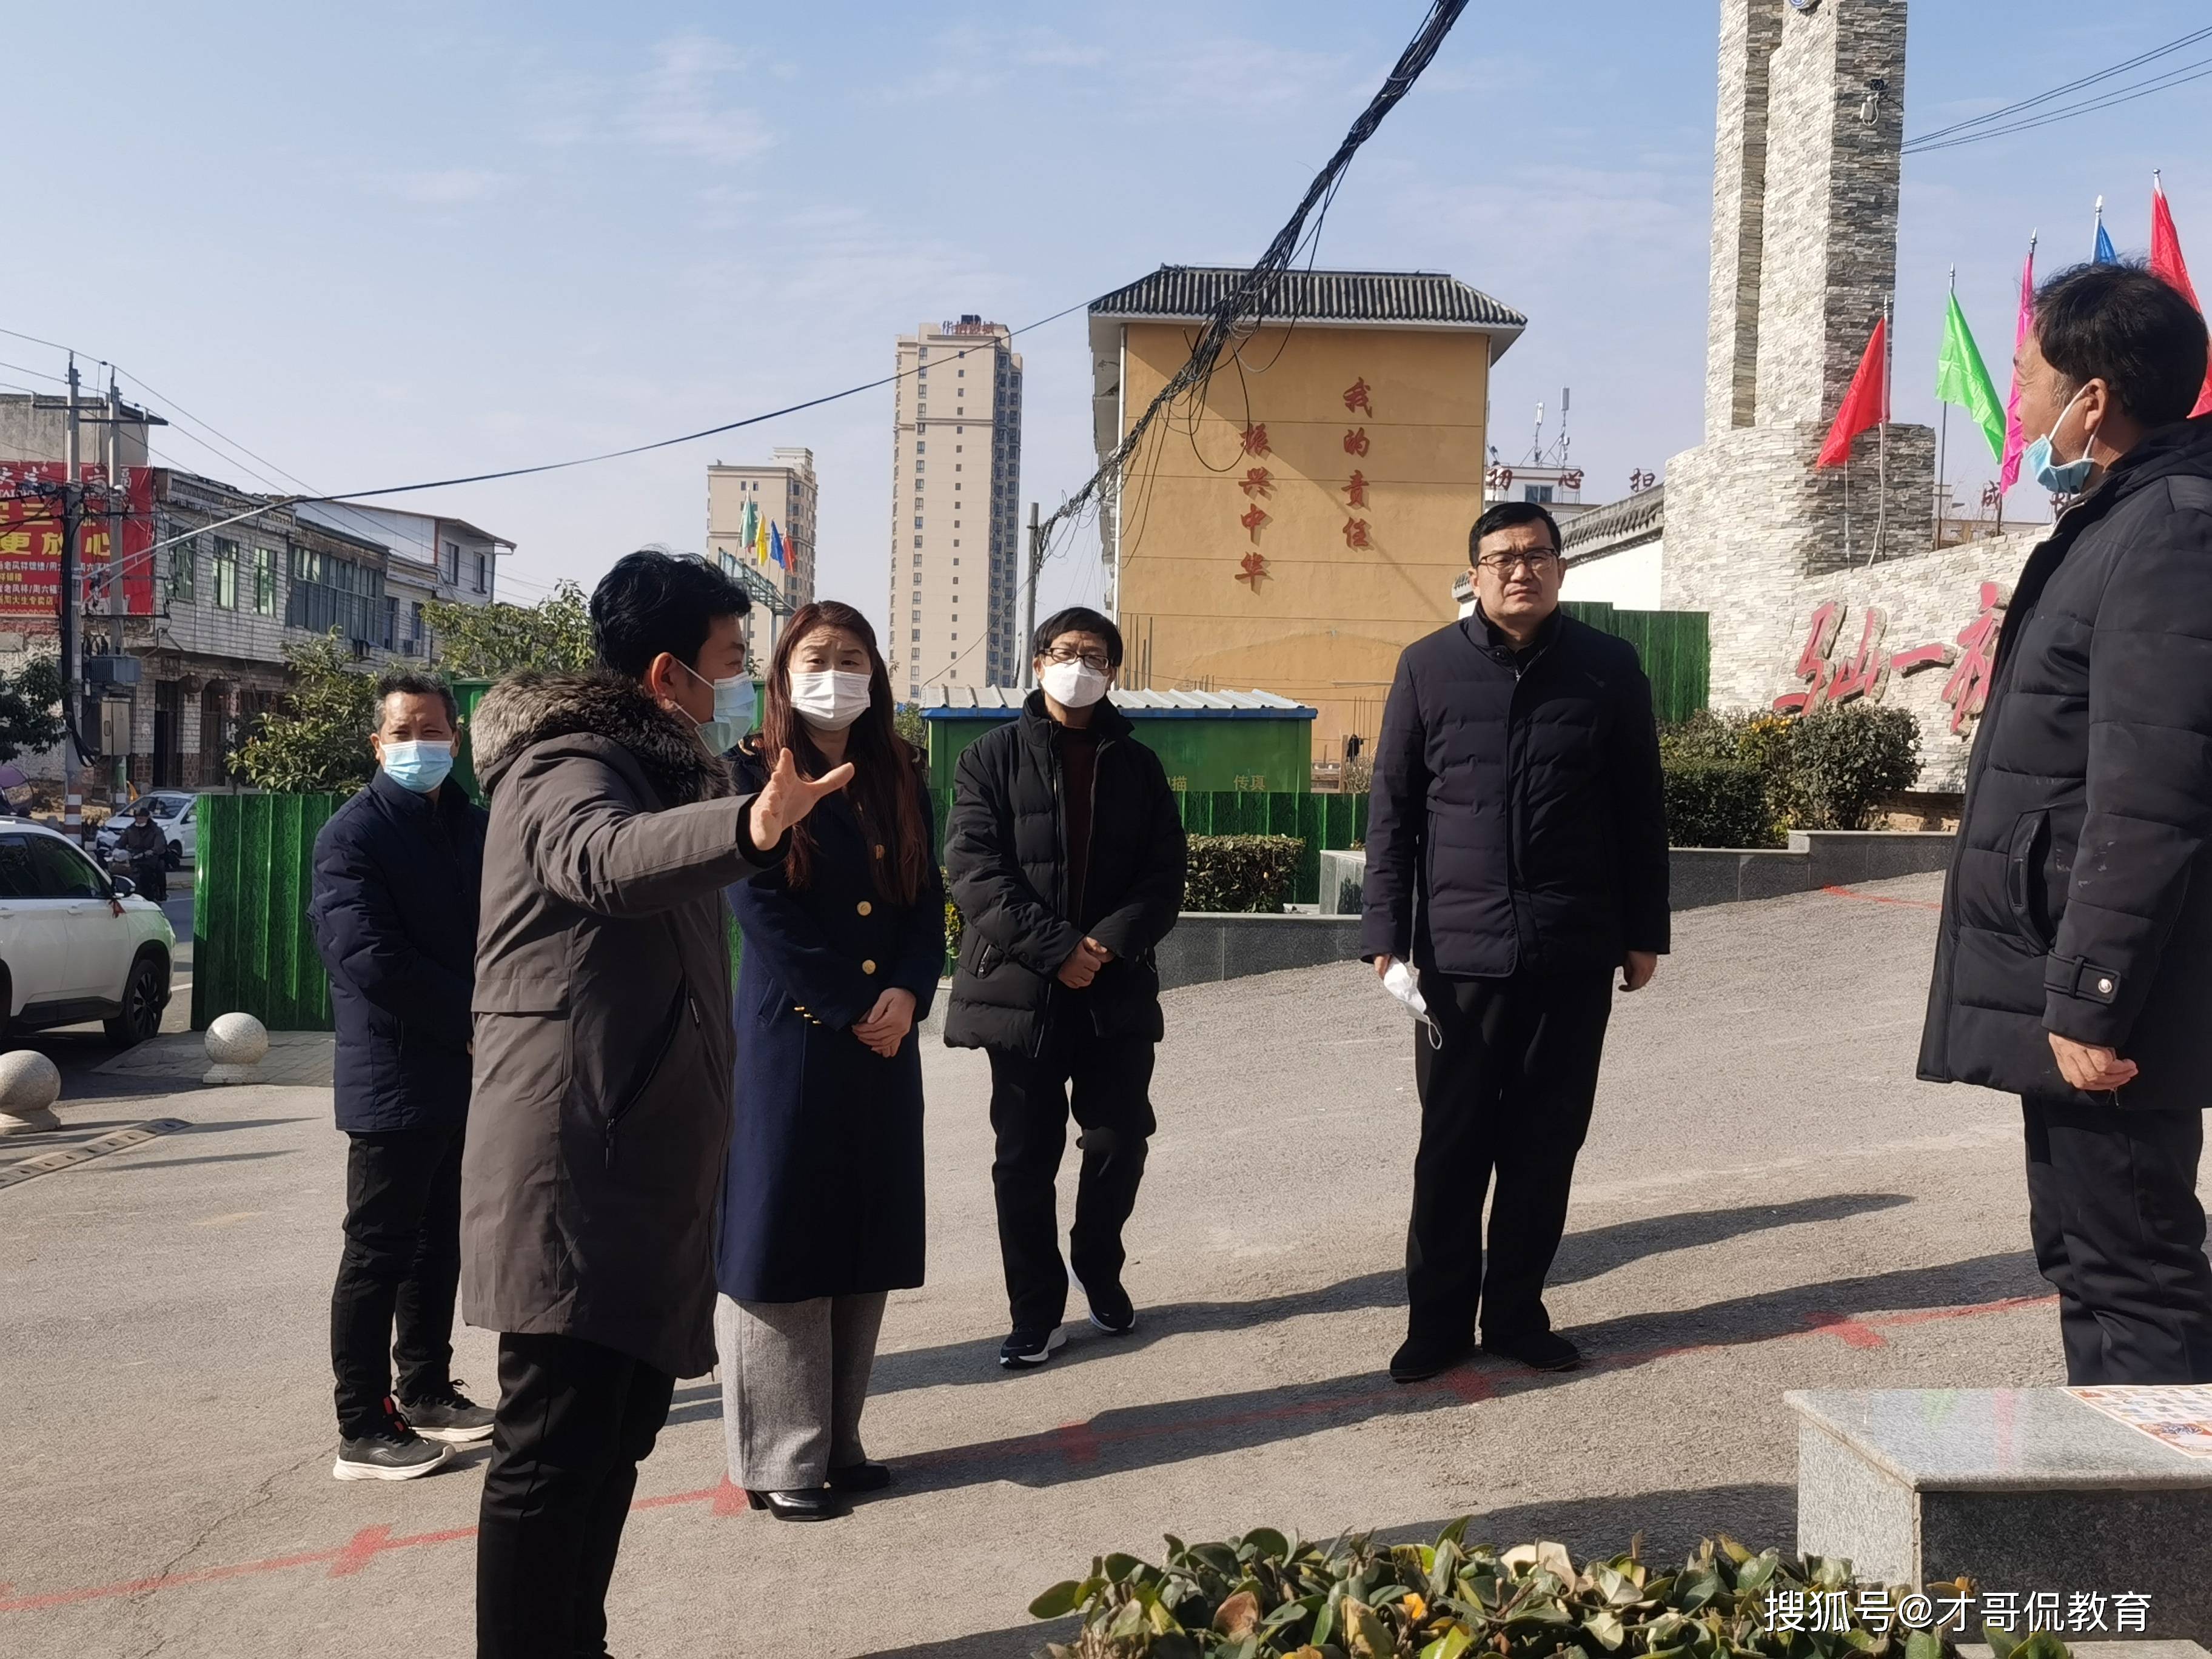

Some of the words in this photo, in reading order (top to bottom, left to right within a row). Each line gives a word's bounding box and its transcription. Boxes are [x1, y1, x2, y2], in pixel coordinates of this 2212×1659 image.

[1235, 423, 1273, 594] 振兴中华
[1341, 377, 1373, 551] 我的责任
[1233, 774, 1265, 791] 传真
